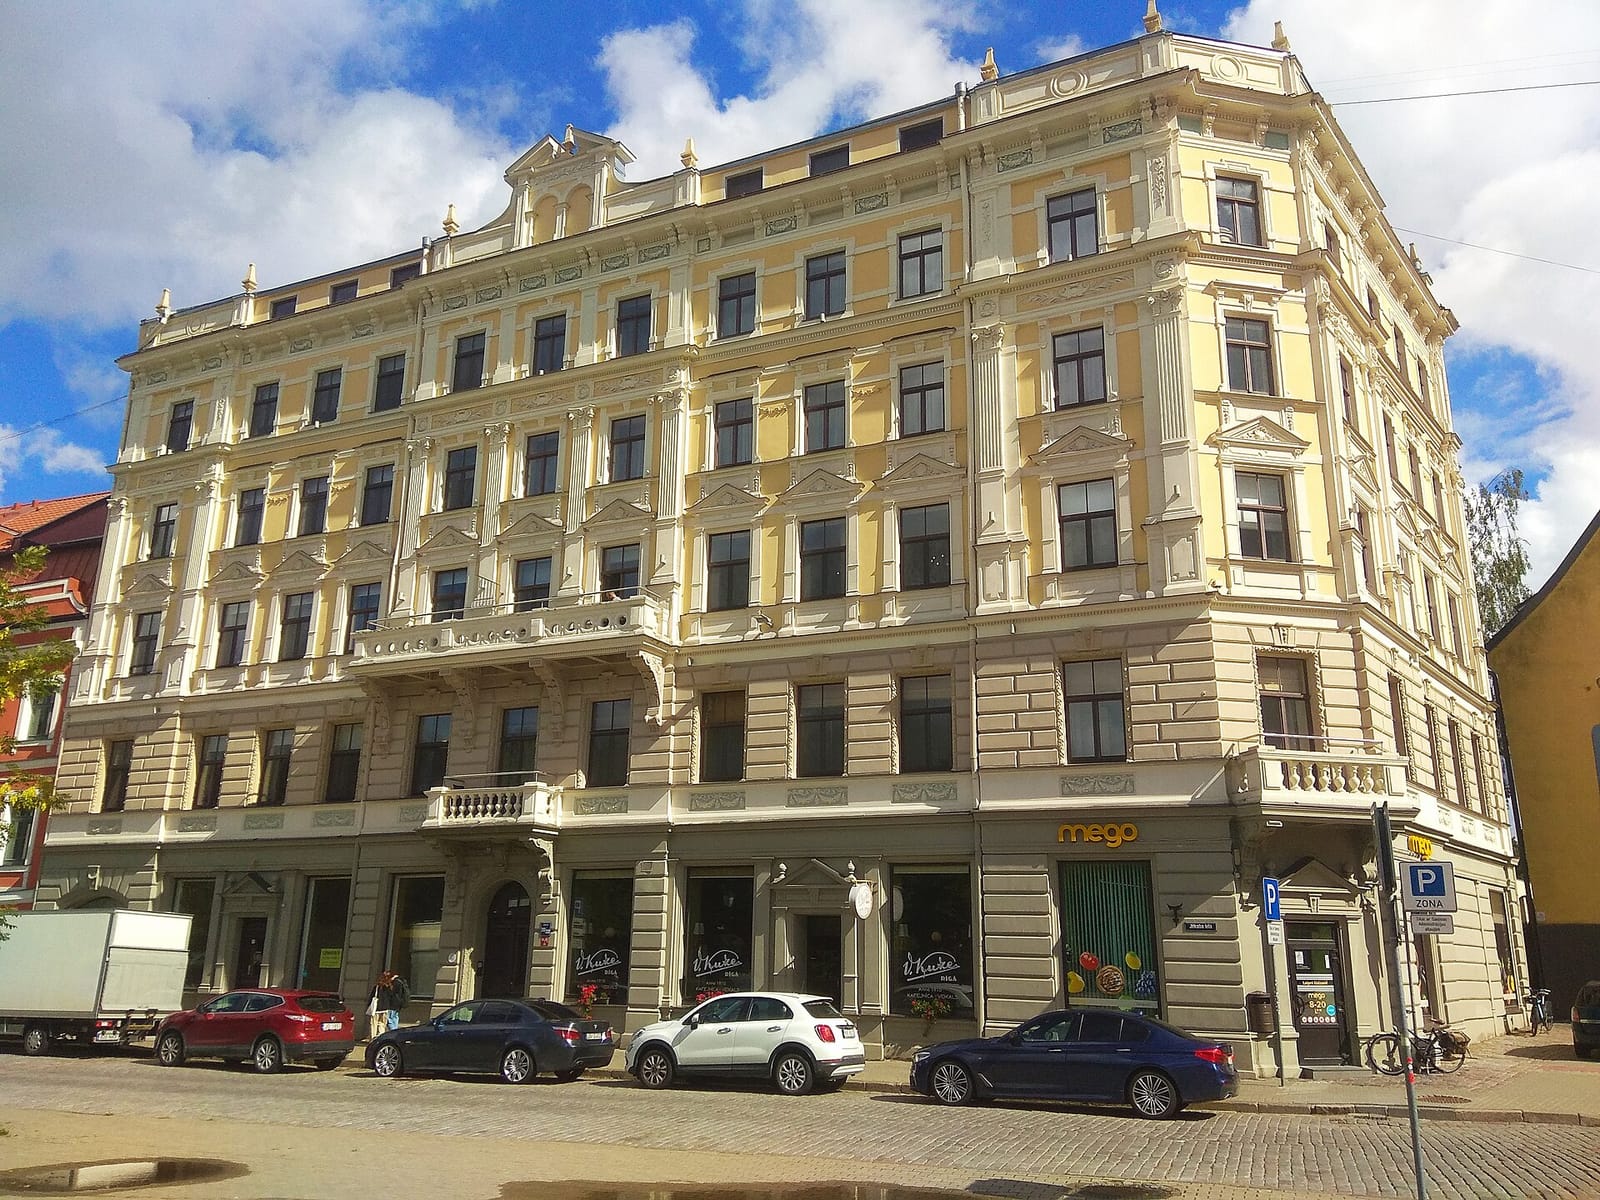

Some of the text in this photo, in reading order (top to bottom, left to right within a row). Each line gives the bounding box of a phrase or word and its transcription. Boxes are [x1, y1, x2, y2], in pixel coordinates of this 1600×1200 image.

[1058, 823, 1138, 848] mego
[1416, 869, 1436, 893] P
[1267, 883, 1276, 915] P
[1415, 899, 1444, 908] ZONA
[1307, 992, 1326, 1000] mego
